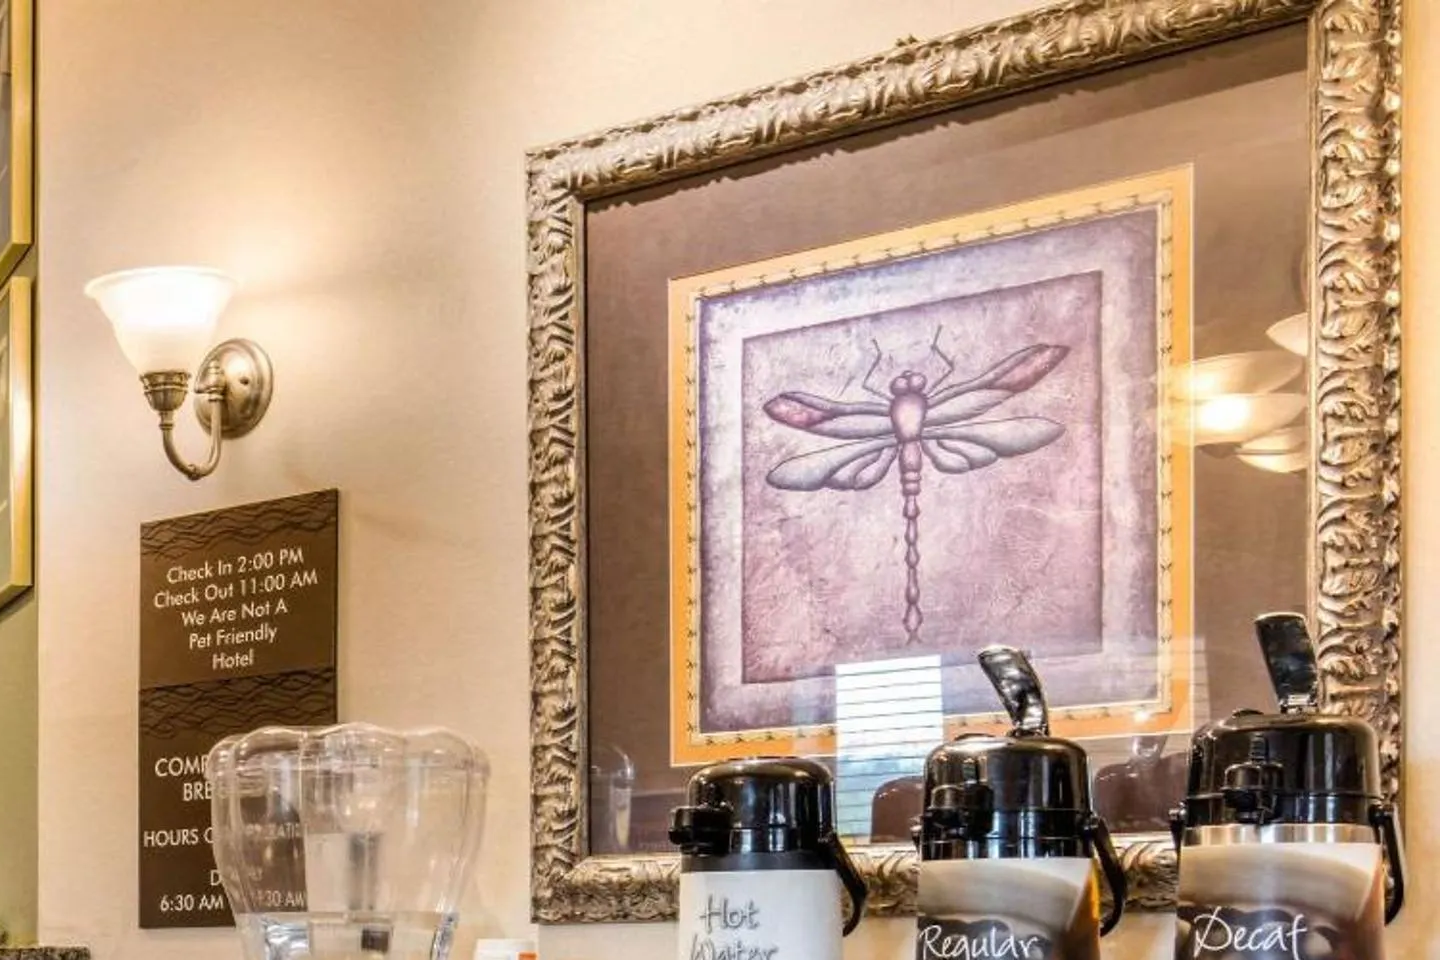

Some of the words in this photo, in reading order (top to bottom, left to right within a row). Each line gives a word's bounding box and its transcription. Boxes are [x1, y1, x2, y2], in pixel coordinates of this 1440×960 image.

[166, 561, 213, 585] Check
[218, 559, 233, 576] In
[237, 552, 274, 575] 2:00
[279, 547, 304, 567] PM
[153, 586, 200, 609] Check
[204, 583, 234, 601] Out
[240, 572, 286, 596] 11:00
[290, 568, 319, 589] AM
[181, 610, 205, 627] We
[209, 607, 237, 624] Are
[241, 601, 272, 618] Not
[275, 597, 288, 614] A
[189, 632, 212, 650] Pet
[216, 622, 278, 647] Friendly
[212, 648, 254, 671] Hotel
[143, 828, 200, 848] HOURS
[160, 894, 195, 913] 6:30
[198, 892, 225, 911] AM
[699, 893, 761, 935] Hot
